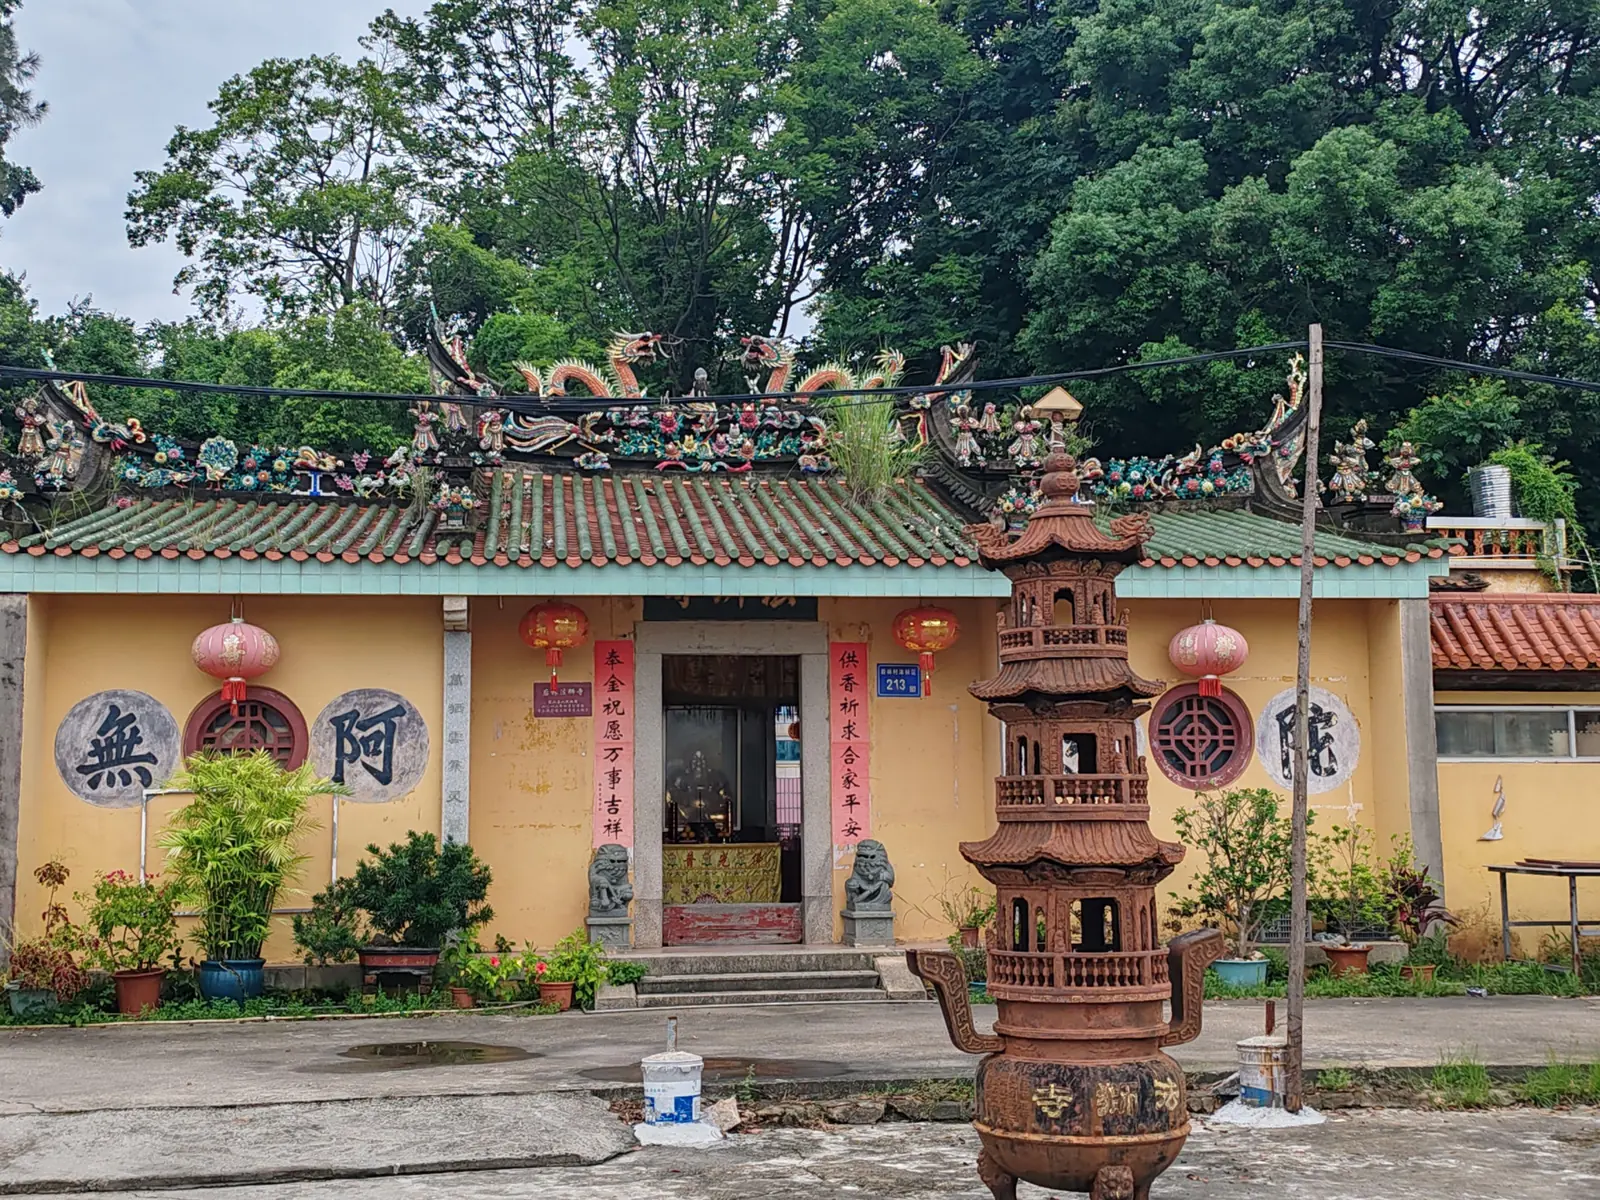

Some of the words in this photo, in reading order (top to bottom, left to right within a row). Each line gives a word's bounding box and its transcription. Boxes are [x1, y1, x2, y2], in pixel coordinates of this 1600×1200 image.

[330, 704, 407, 786] 阿
[603, 648, 626, 840] 奉金祝愿万事吉祥
[839, 650, 862, 837] 供香祈求合家平安
[886, 678, 906, 691] 213
